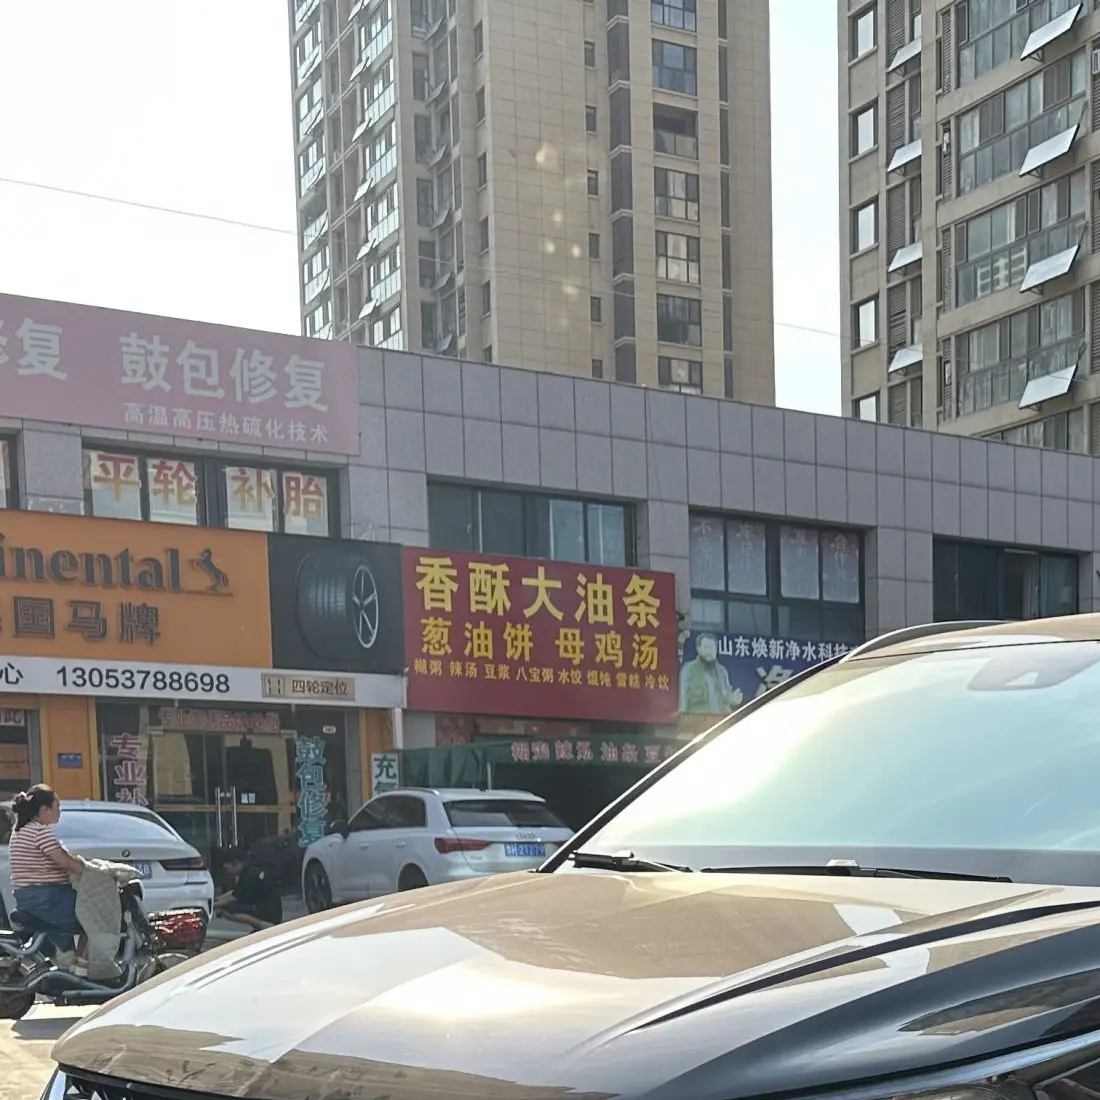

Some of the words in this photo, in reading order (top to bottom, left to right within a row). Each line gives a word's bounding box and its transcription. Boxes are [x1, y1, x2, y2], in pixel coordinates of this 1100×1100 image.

[0, 316, 68, 380] 复
[119, 332, 330, 413] 鼓包修复
[124, 403, 329, 444] 高温高压热硫化技术
[93, 454, 197, 506] 平轮
[232, 468, 324, 519] 补胎
[415, 556, 662, 629] 香酥大油条
[0, 596, 161, 645] 国马牌
[420, 617, 534, 662] 葱油饼
[555, 627, 659, 671] 母鸡汤
[57, 666, 231, 693] 13053788698
[291, 679, 349, 697] 四轮定位
[450, 660, 478, 678] 辣汤
[484, 663, 510, 681] 豆浆
[516, 666, 554, 684] 八宝粥
[558, 668, 582, 685] 水饺
